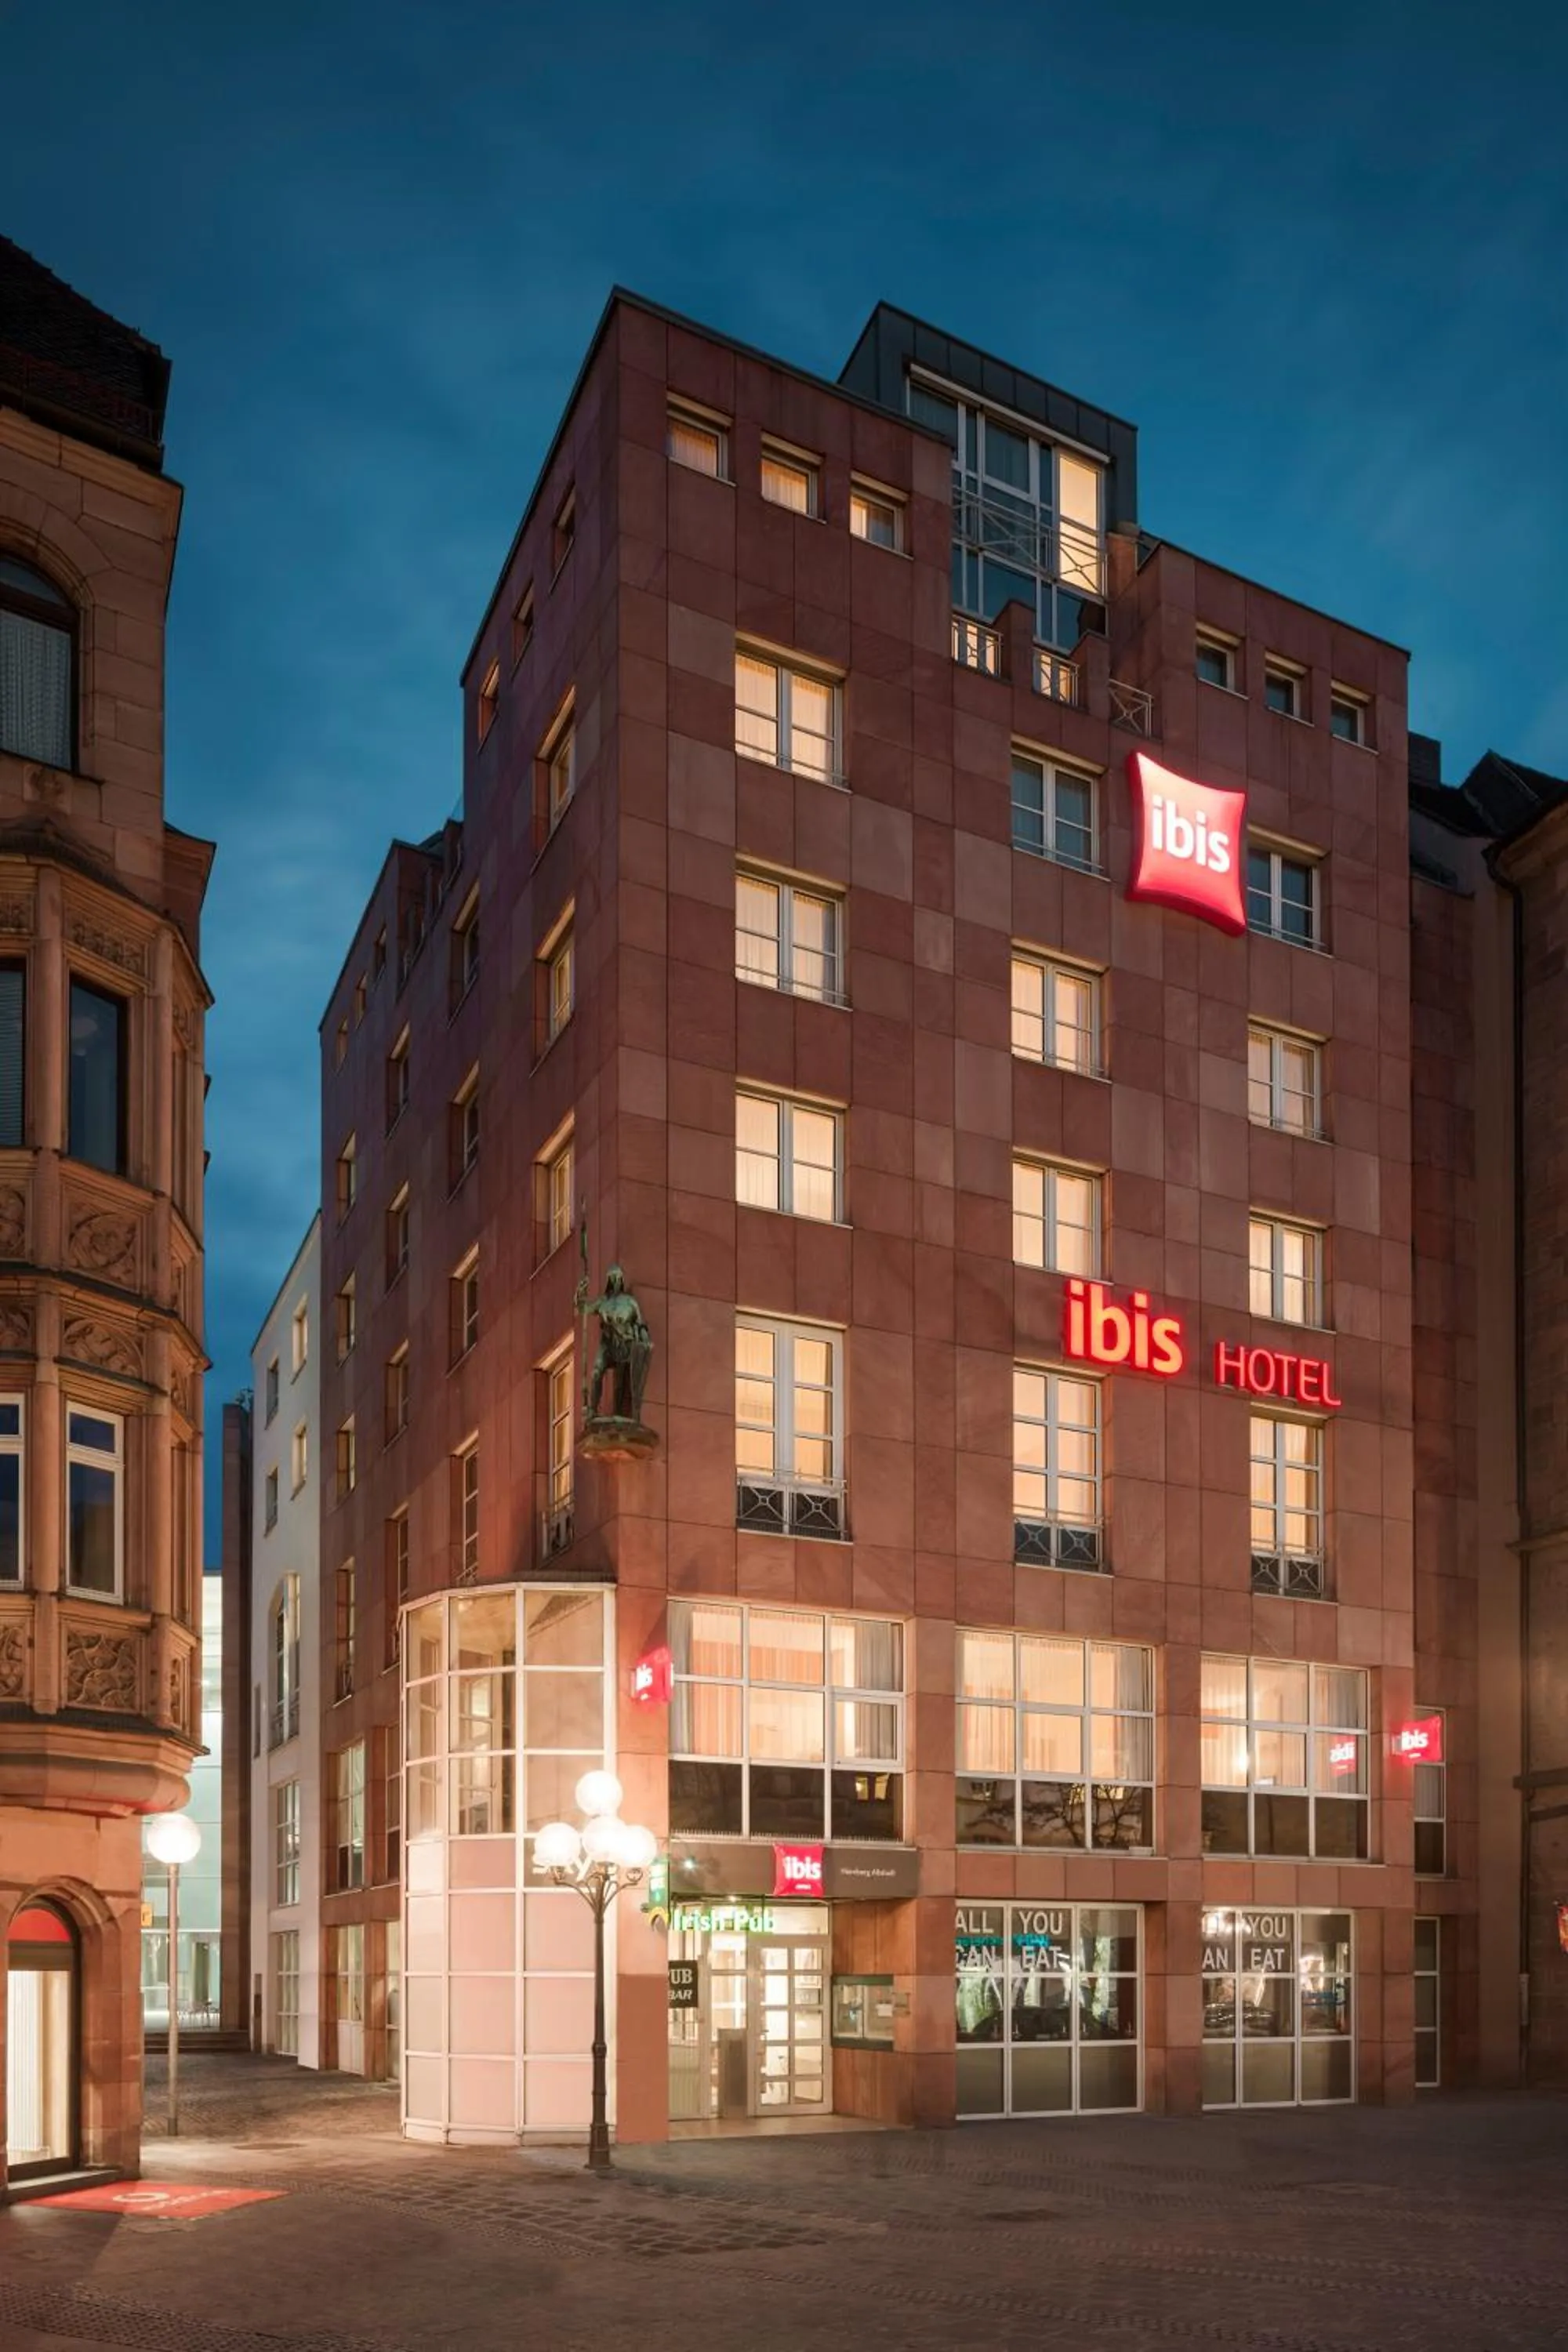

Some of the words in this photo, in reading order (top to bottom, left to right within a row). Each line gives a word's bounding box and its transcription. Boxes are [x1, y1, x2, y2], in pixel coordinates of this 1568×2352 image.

[1152, 794, 1230, 873] ibis
[1067, 1278, 1185, 1374] ibis
[1218, 1341, 1343, 1406] HOTEL
[784, 1856, 822, 1880] ibis
[673, 1907, 725, 1932] Irish
[734, 1907, 776, 1933] Pub
[955, 1909, 994, 1934] ALL
[1018, 1910, 1063, 1935] YOU
[1247, 1915, 1287, 1938] YOU
[1022, 1944, 1062, 1969] EAT
[1202, 1947, 1229, 1970] AN
[1250, 1947, 1285, 1970] EAT
[668, 1969, 693, 1984] UB
